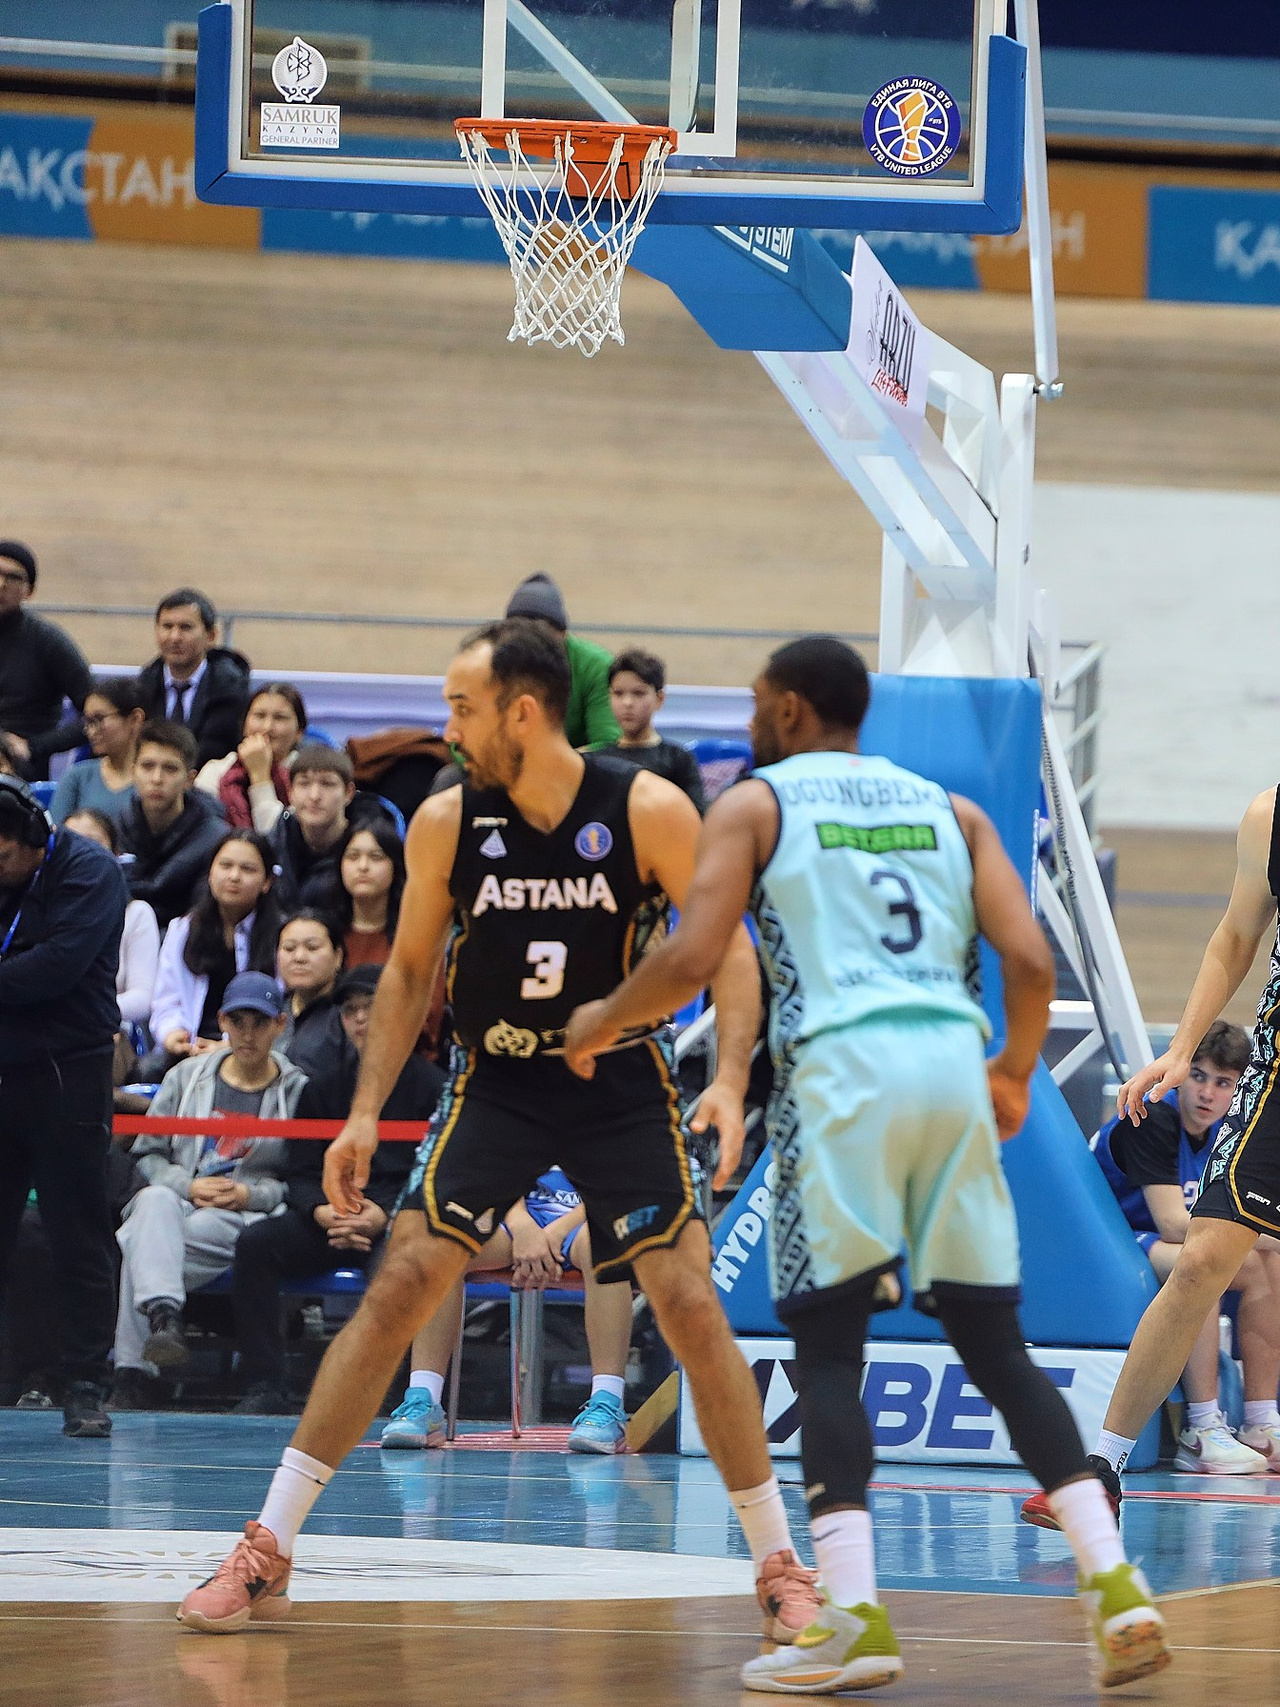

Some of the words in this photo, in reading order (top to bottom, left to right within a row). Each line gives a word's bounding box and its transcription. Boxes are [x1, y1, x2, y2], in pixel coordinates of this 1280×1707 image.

[871, 79, 910, 108] ЕДИНАЯ
[911, 79, 937, 95] ЛИГА
[936, 91, 953, 109] ВТБ
[262, 125, 338, 135] KAZYNA
[263, 107, 338, 124] SAMRUK
[261, 134, 300, 144] GENERAL
[302, 136, 338, 146] PARTNER
[870, 143, 885, 163] VTB
[884, 158, 919, 175] UNITED
[920, 145, 953, 174] LEAGUE
[471, 872, 619, 917] ASTANA
[871, 871, 923, 954] 3
[520, 941, 568, 1000] 3
